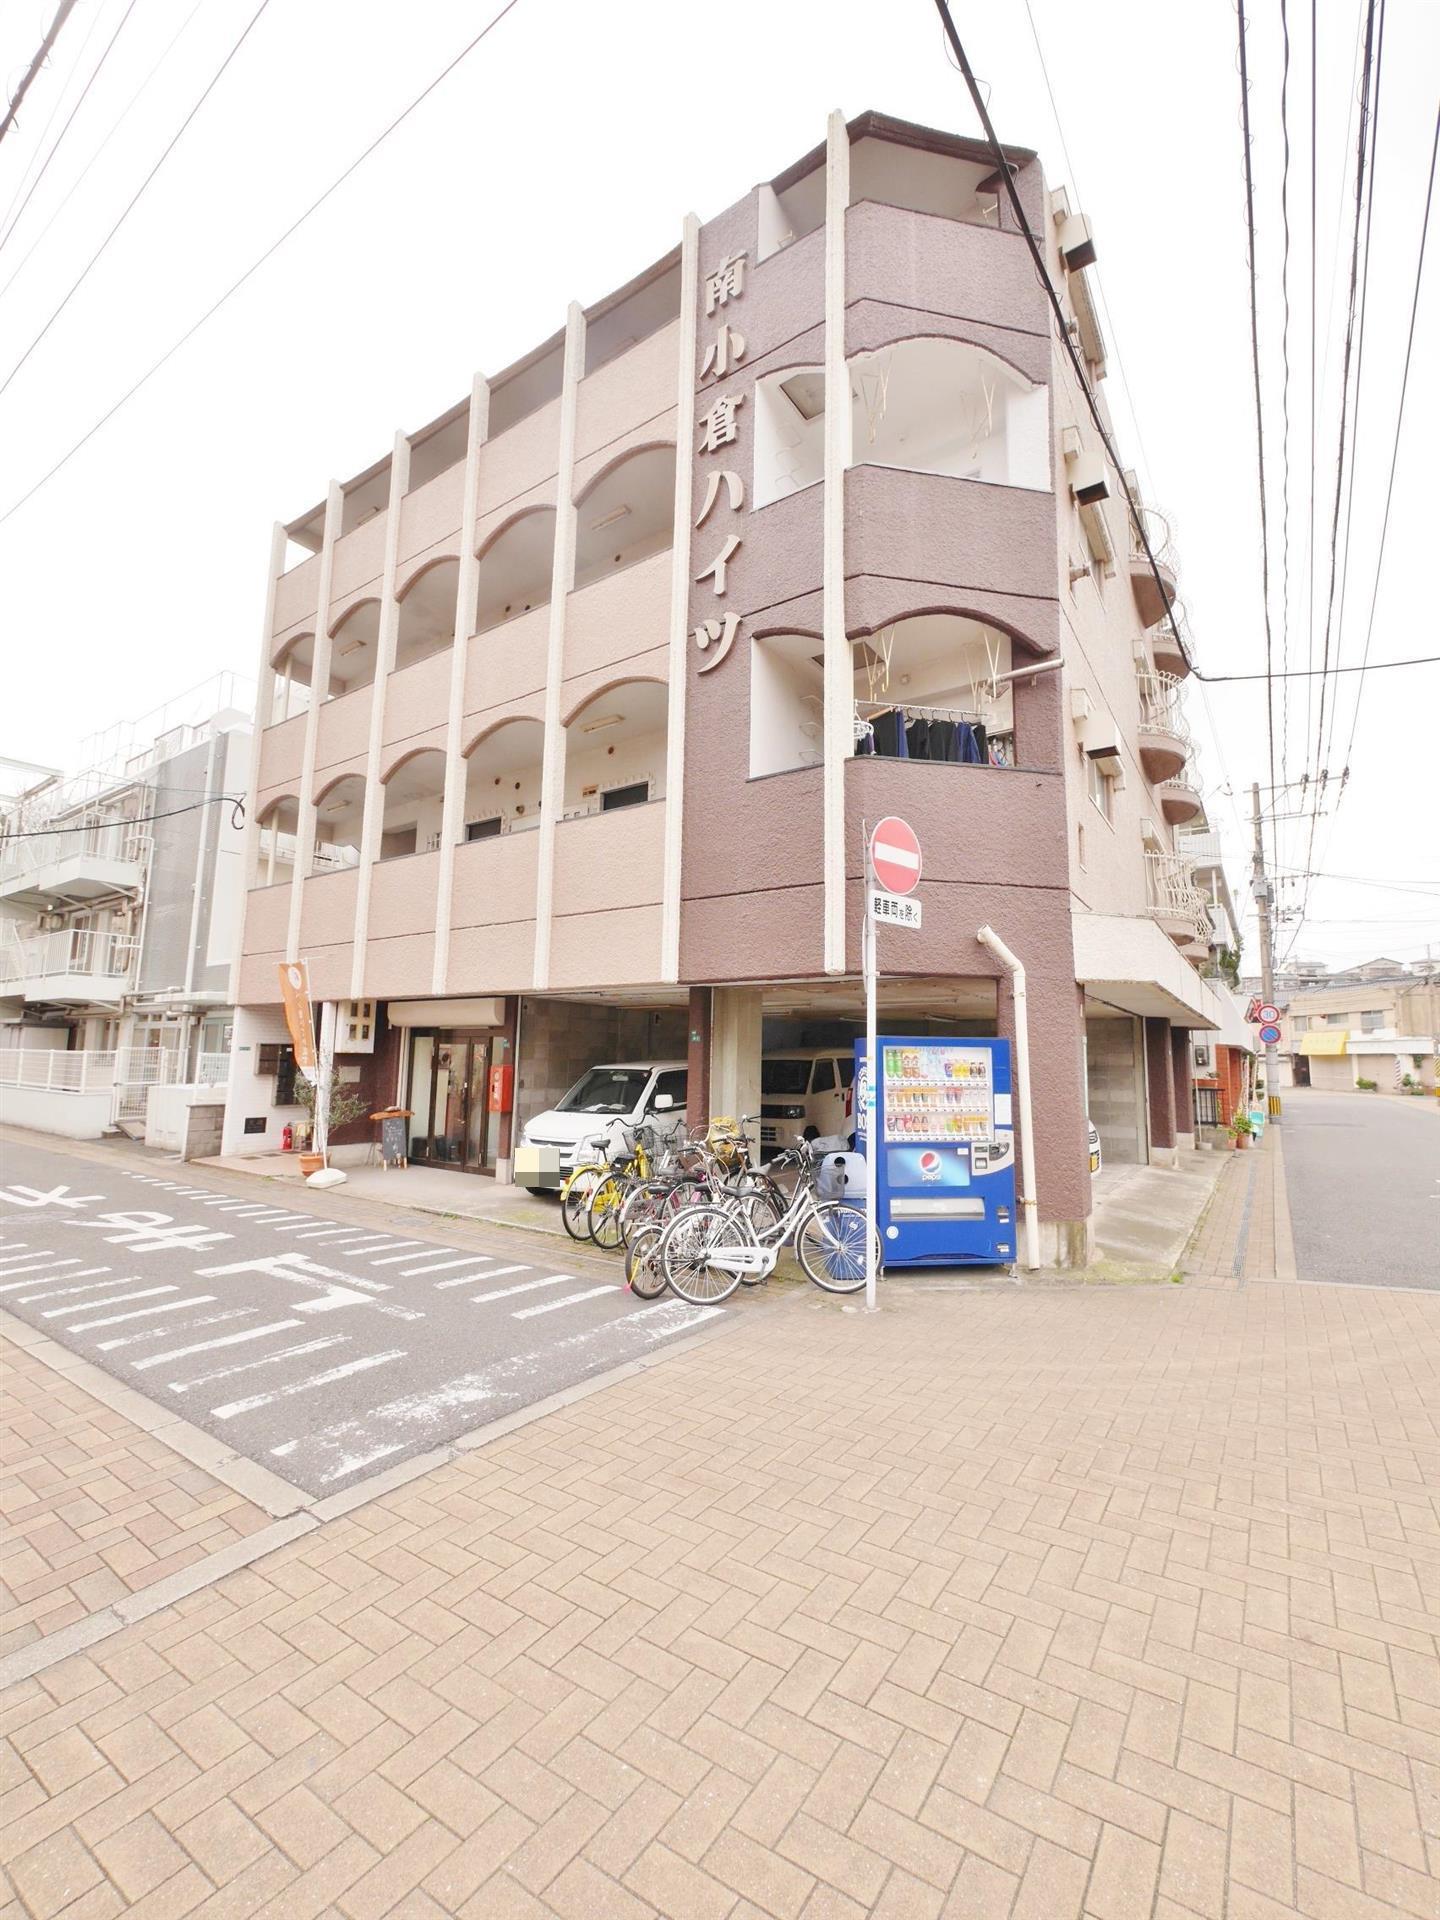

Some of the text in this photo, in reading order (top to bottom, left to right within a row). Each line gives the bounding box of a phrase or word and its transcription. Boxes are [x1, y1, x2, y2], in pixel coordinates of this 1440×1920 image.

[693, 248, 748, 676] 南小倉ハイツ
